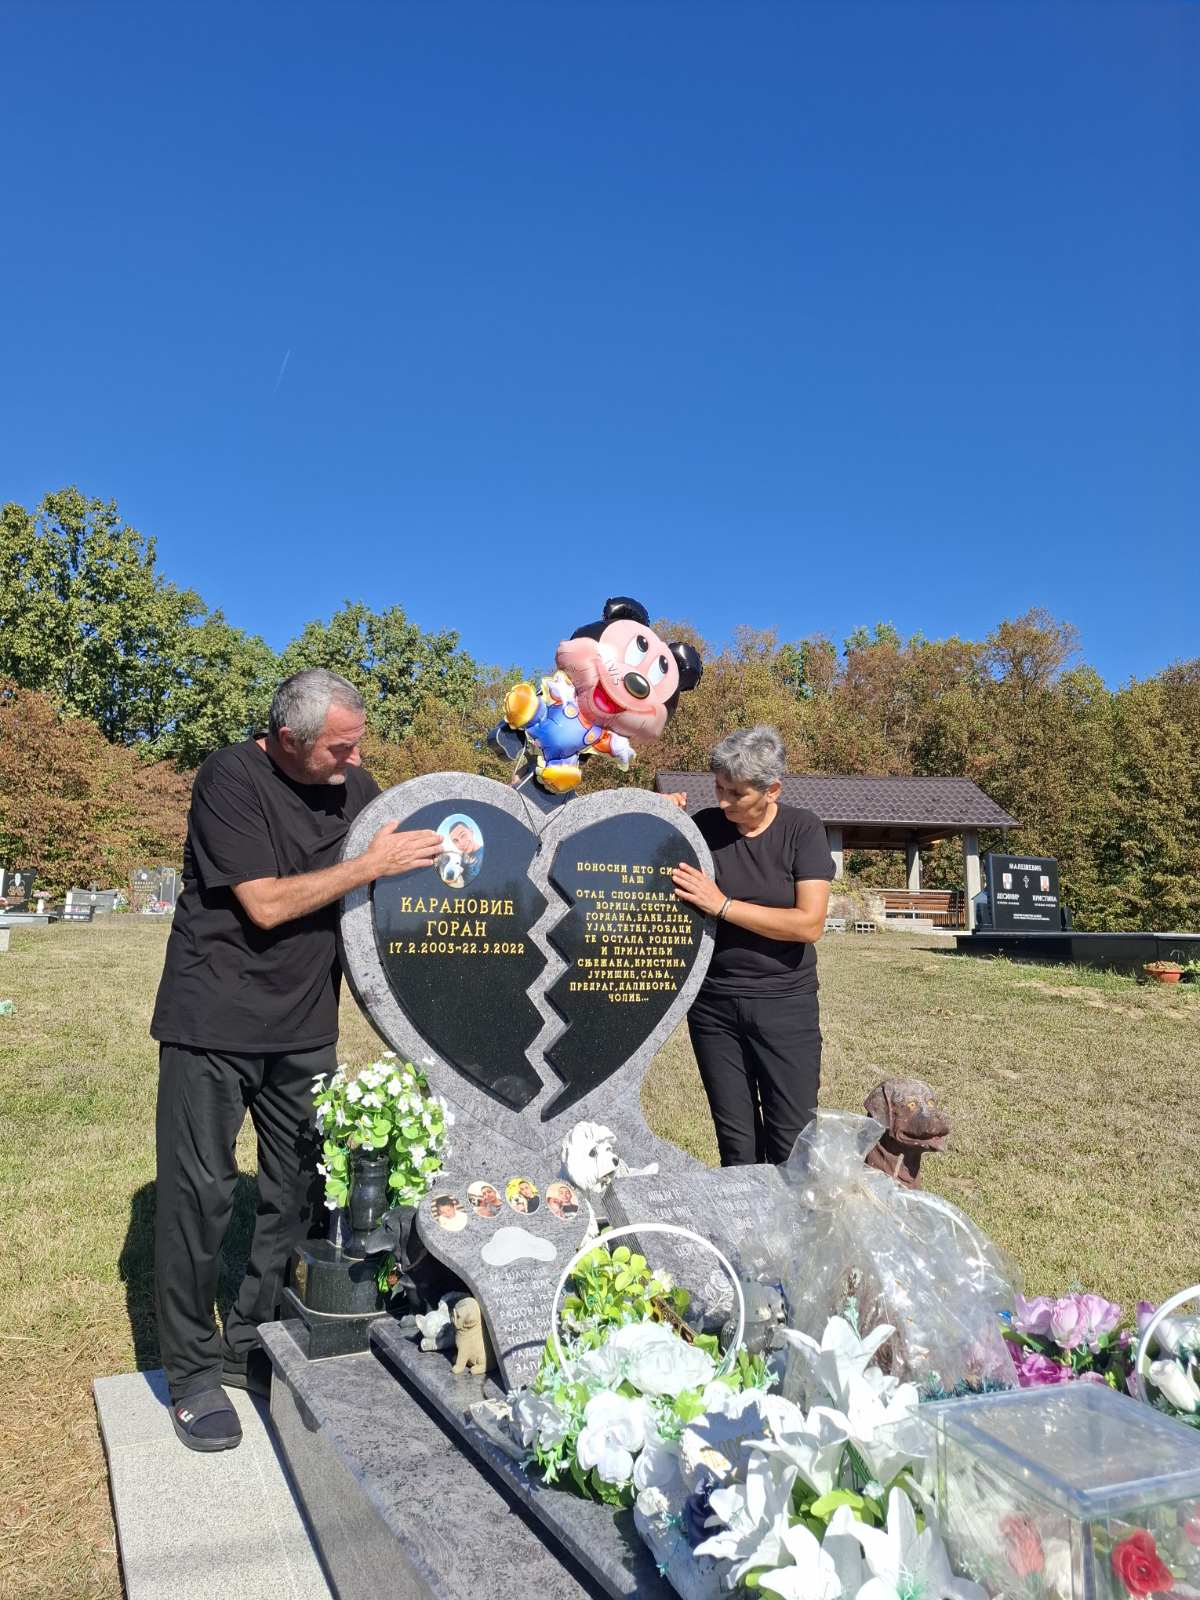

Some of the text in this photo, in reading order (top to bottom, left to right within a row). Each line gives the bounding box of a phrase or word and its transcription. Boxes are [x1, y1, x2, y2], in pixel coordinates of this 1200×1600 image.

[577, 862, 627, 873] ПОНОСНИ
[632, 865, 654, 875] ШТО
[621, 875, 645, 884] НАШ
[576, 889, 605, 899] ОТАЦ
[400, 896, 514, 915] КАРАНОВИЋ
[426, 920, 487, 937] ГОРАН
[584, 934, 597, 943] ТЕ
[600, 946, 673, 956] И ПРИЈАТЕЉИ
